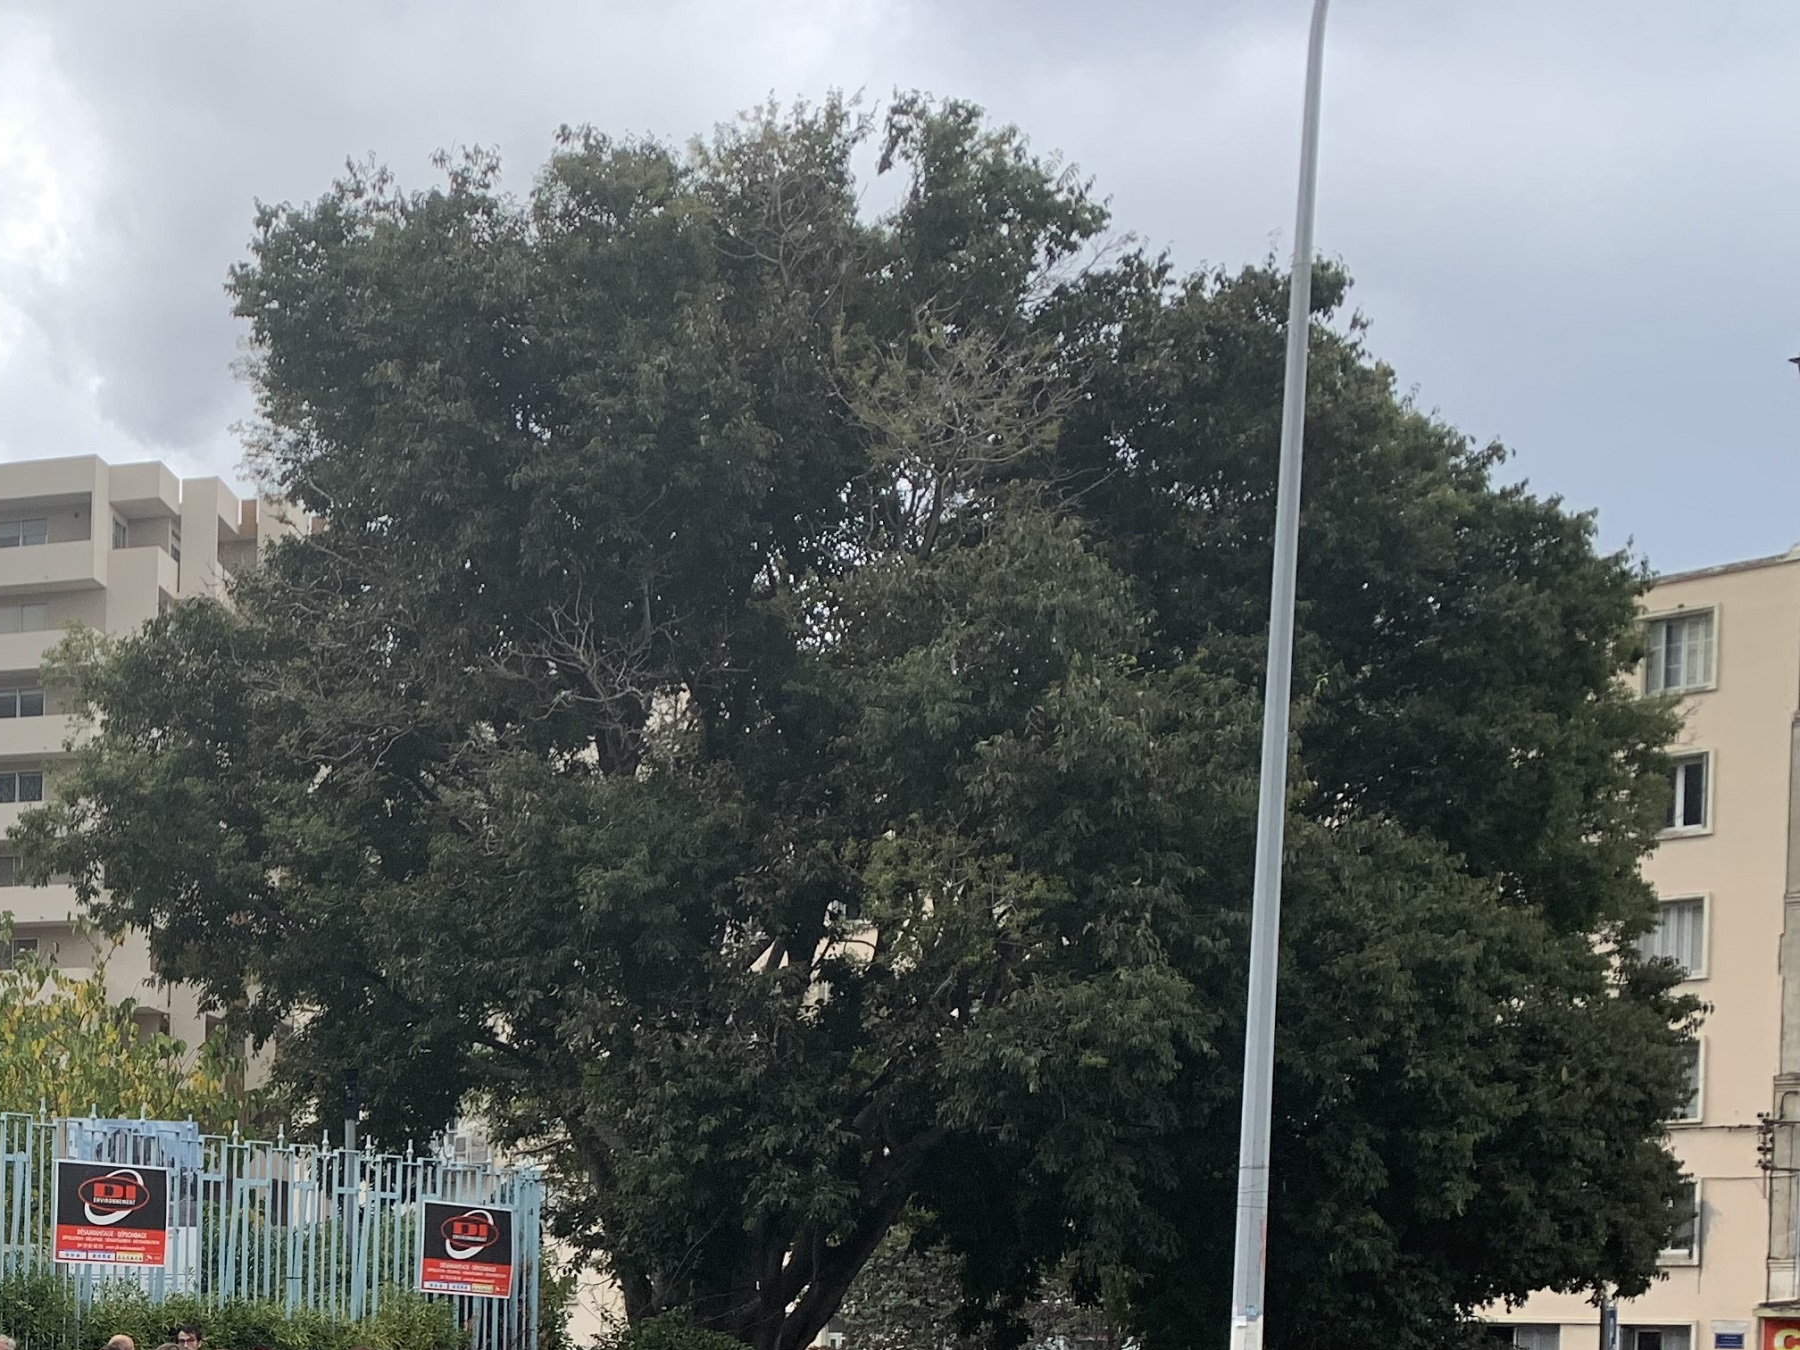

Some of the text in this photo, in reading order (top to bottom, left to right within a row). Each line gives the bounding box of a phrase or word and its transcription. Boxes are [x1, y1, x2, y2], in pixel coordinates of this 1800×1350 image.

[93, 1183, 137, 1200] DI
[93, 1197, 136, 1206] ENVIRONNEMENT
[453, 1221, 488, 1237] DI
